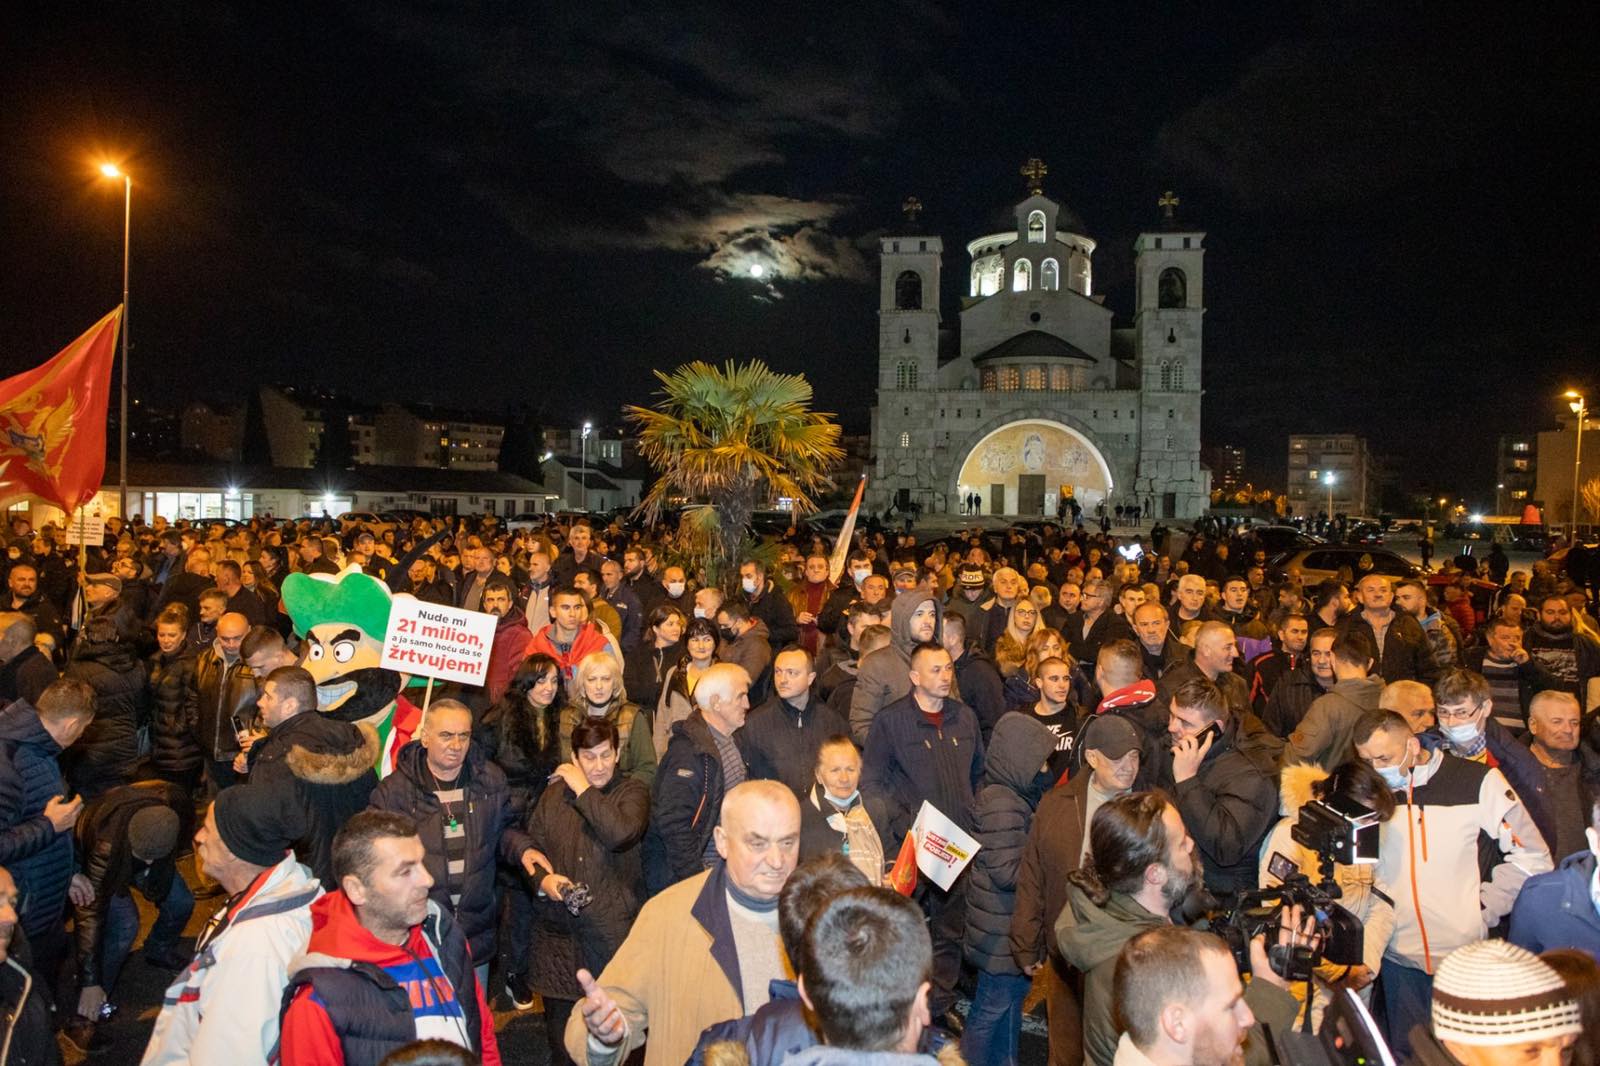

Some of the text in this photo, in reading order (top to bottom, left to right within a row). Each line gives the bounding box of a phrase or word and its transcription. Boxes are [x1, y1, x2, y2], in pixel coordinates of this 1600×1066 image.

[418, 610, 467, 627] Nude mi
[397, 618, 484, 649] 21 milion,
[399, 635, 408, 644] ja
[409, 640, 434, 649] samo
[435, 643, 457, 653] hoću
[459, 647, 470, 656] da
[388, 644, 483, 675] žrtvujem!
